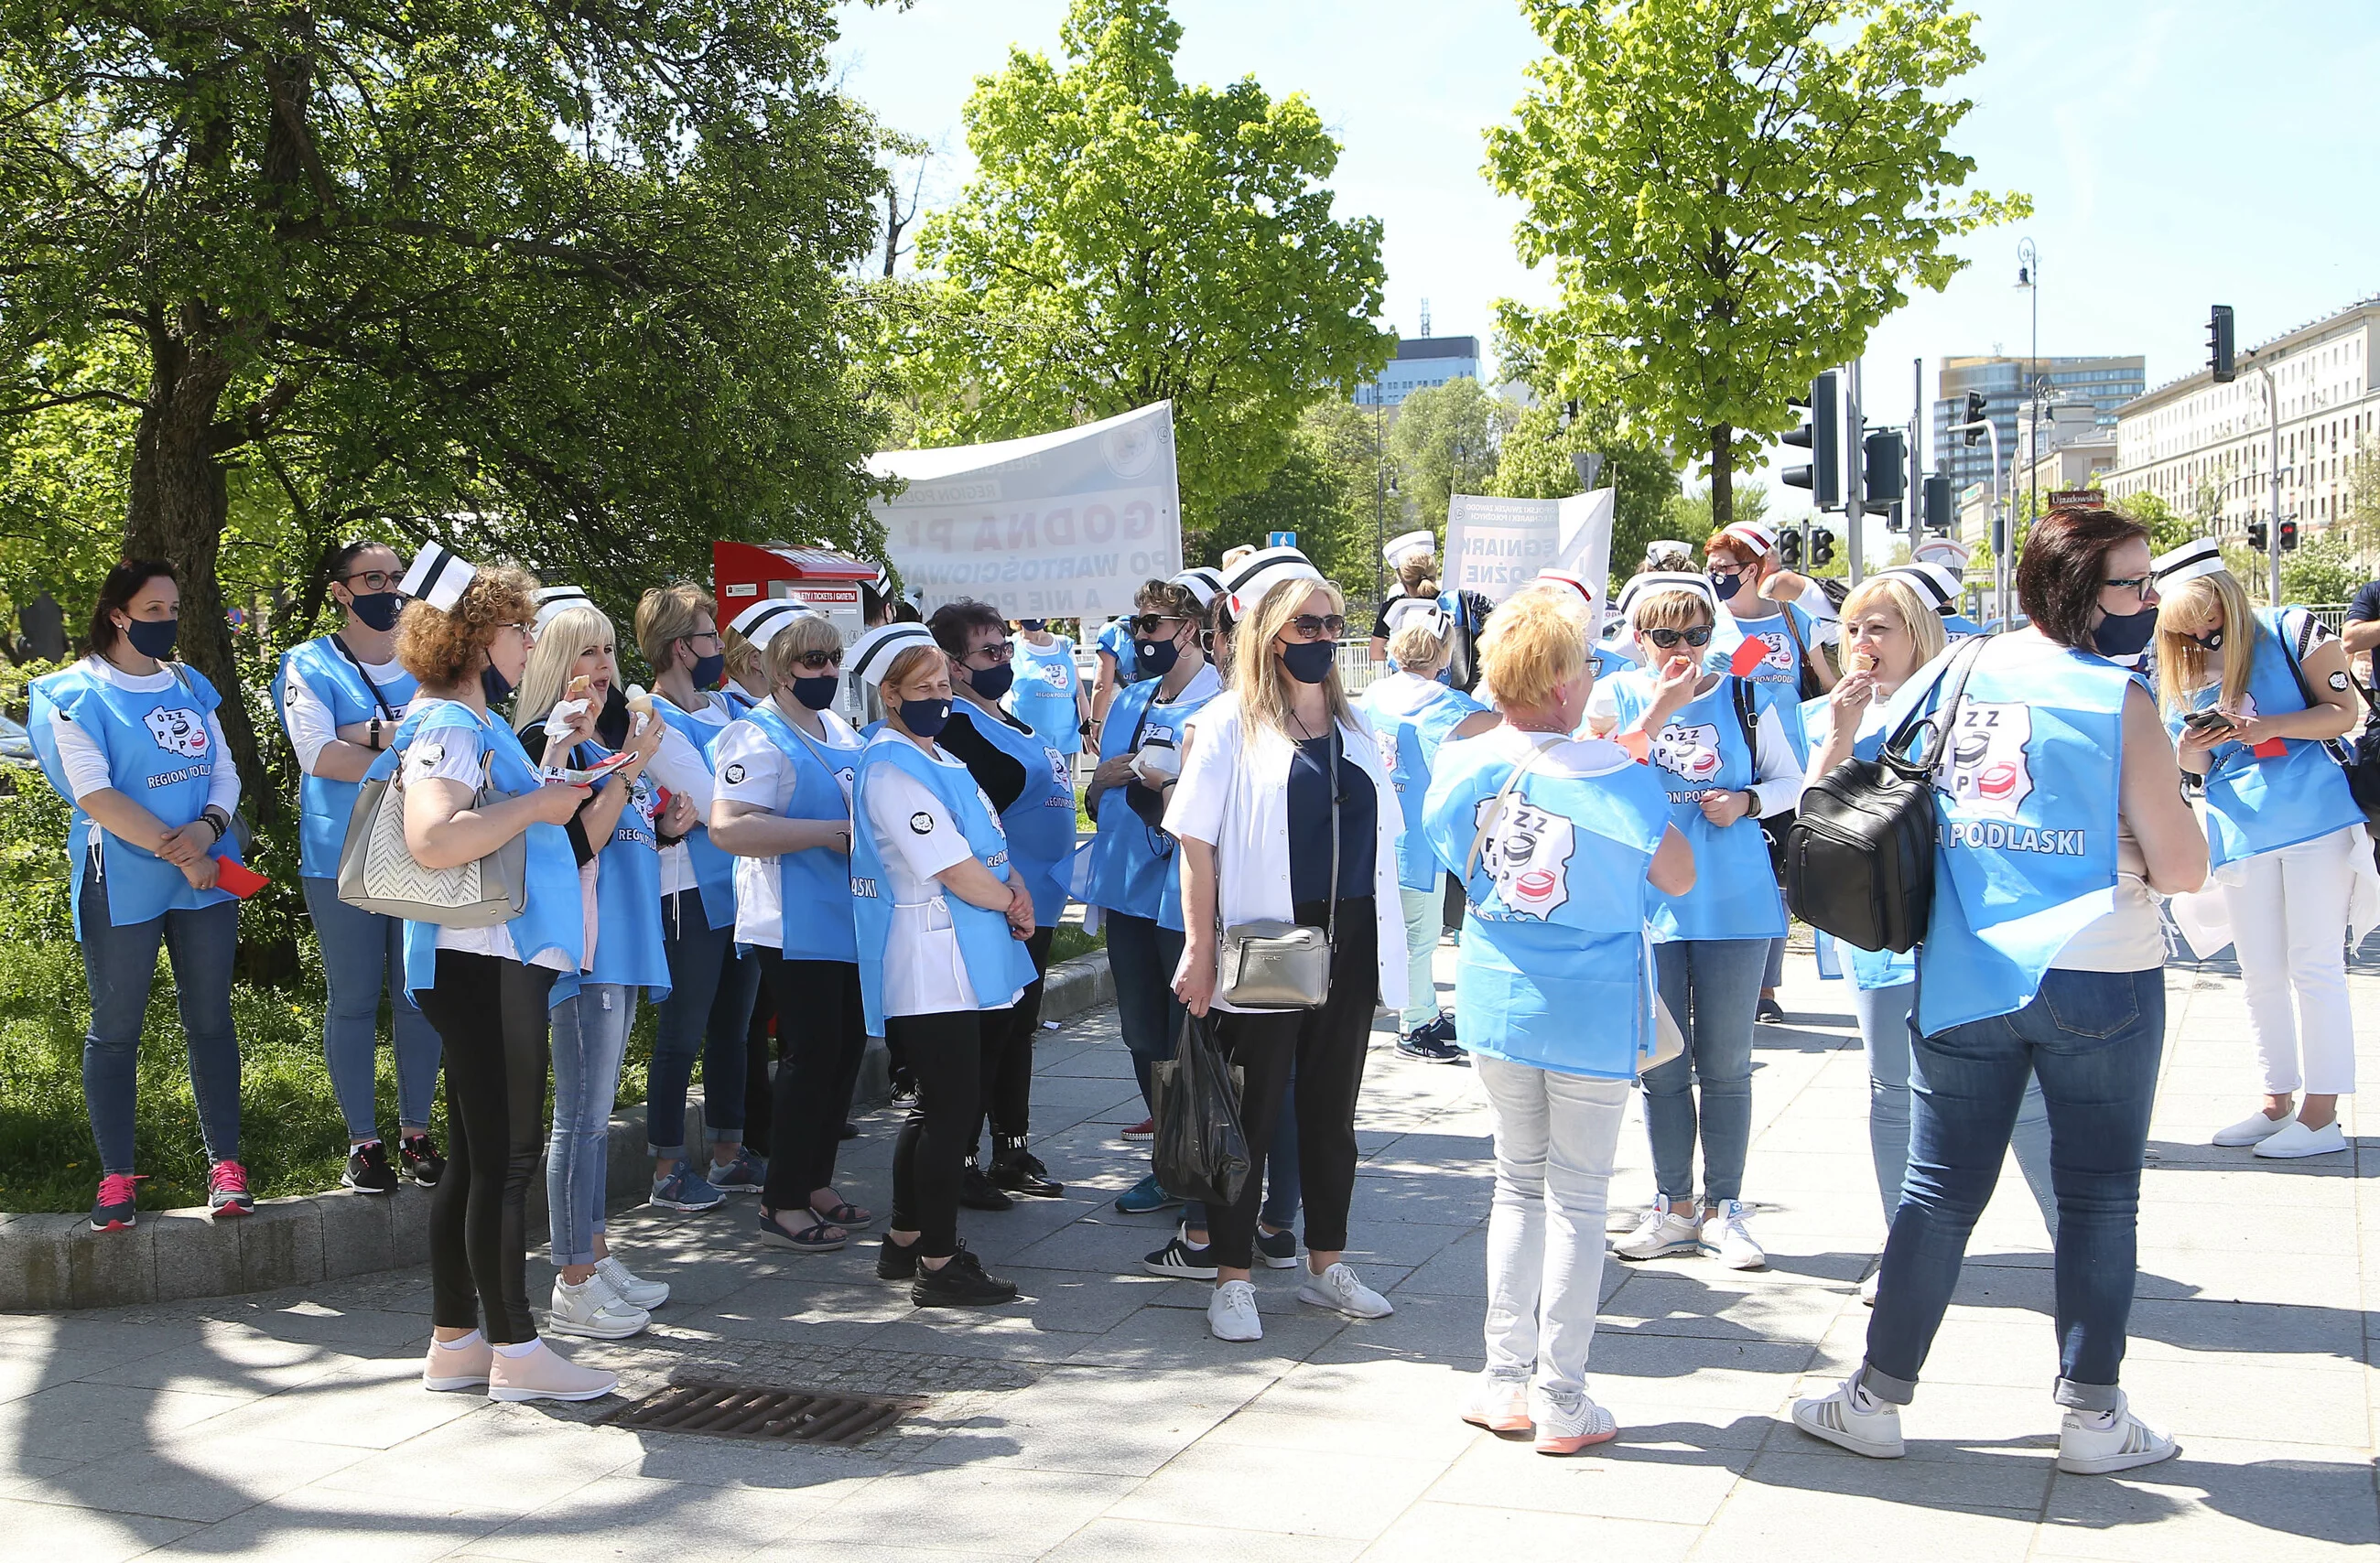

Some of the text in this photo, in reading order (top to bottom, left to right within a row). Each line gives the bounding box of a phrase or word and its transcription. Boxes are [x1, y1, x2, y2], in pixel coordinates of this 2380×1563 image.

[814, 592, 833, 600] TICKETS
[157, 712, 186, 723] OZZ
[1664, 729, 1700, 742] OZZ
[146, 769, 189, 790] REGION
[1949, 822, 2085, 857] PODLASKI
